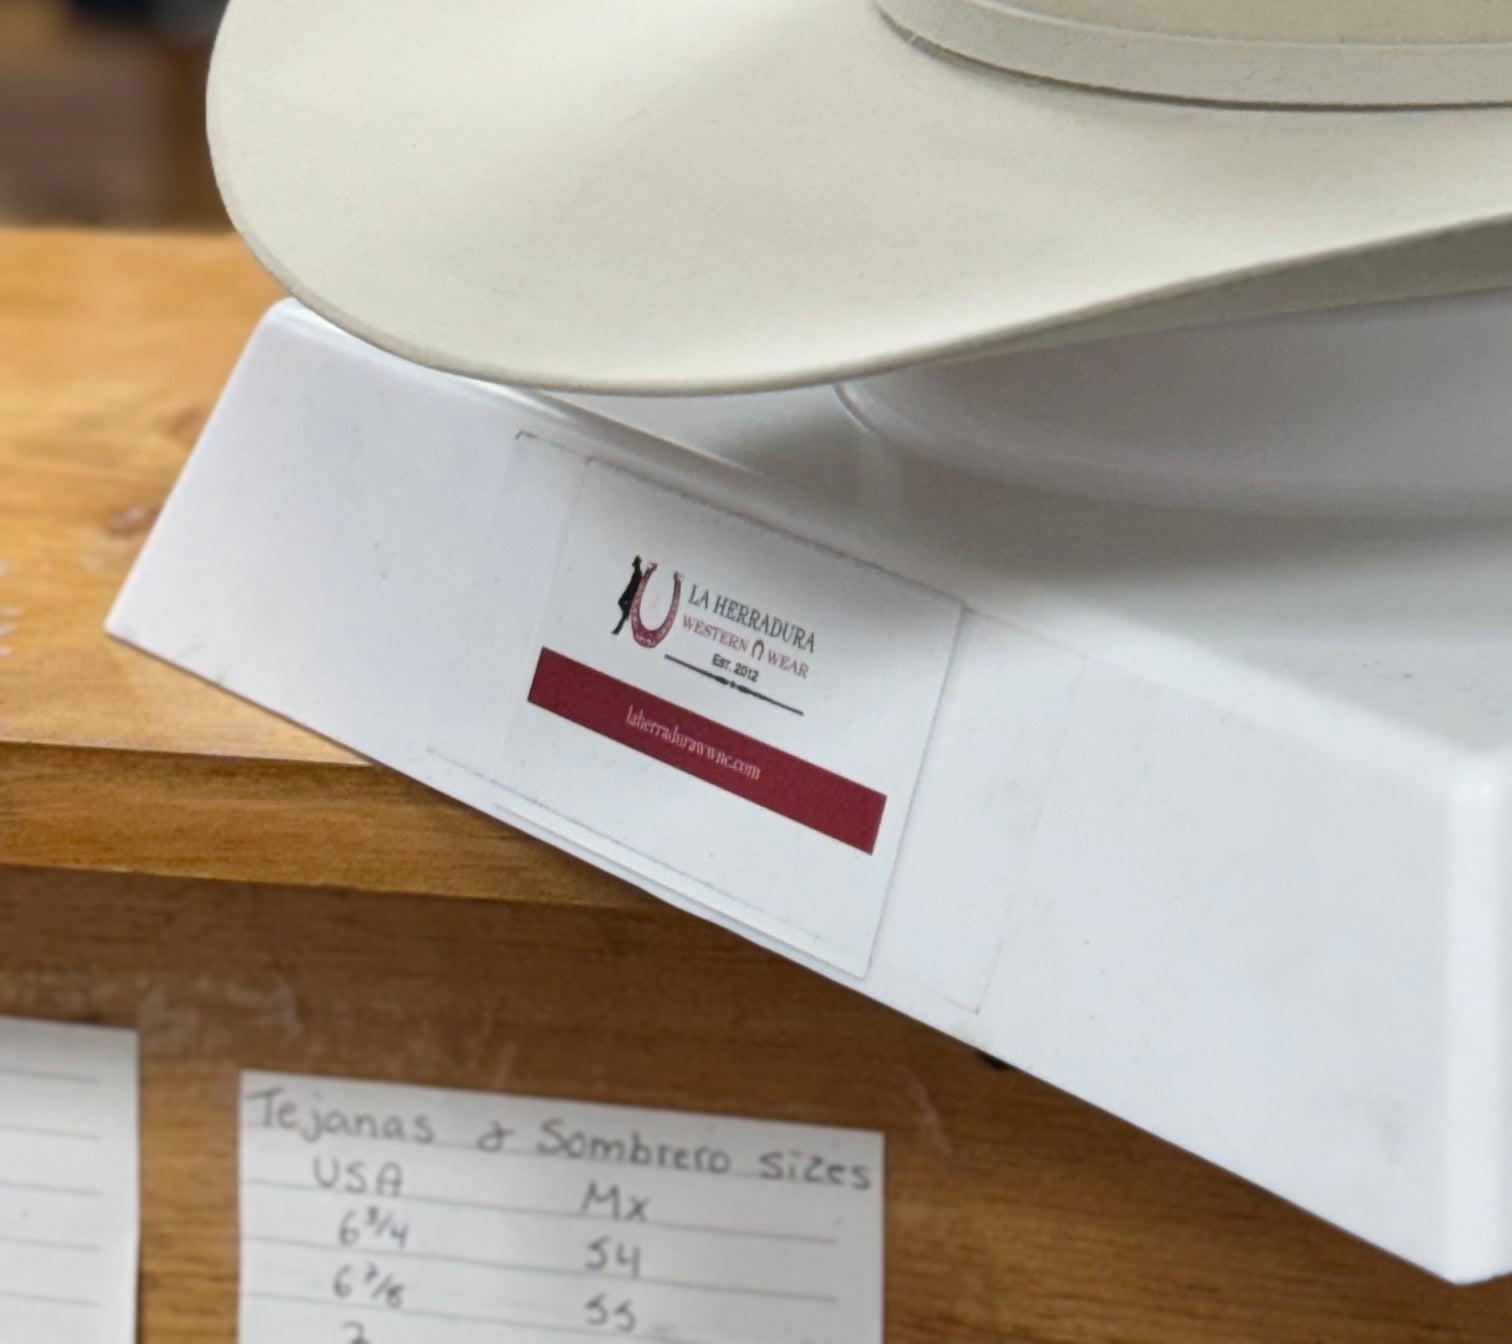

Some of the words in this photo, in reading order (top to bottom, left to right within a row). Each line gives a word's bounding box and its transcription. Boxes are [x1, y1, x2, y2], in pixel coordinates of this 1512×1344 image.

[687, 583, 709, 610] LA
[712, 594, 815, 653] HERRADURA
[682, 613, 750, 652] WESTERN
[766, 649, 809, 679] WEAR
[733, 662, 760, 683] 2012
[246, 1086, 436, 1143] Tejanas
[536, 1117, 732, 1176] Sombrero
[312, 1156, 404, 1198] USA
[585, 1234, 642, 1279] 54
